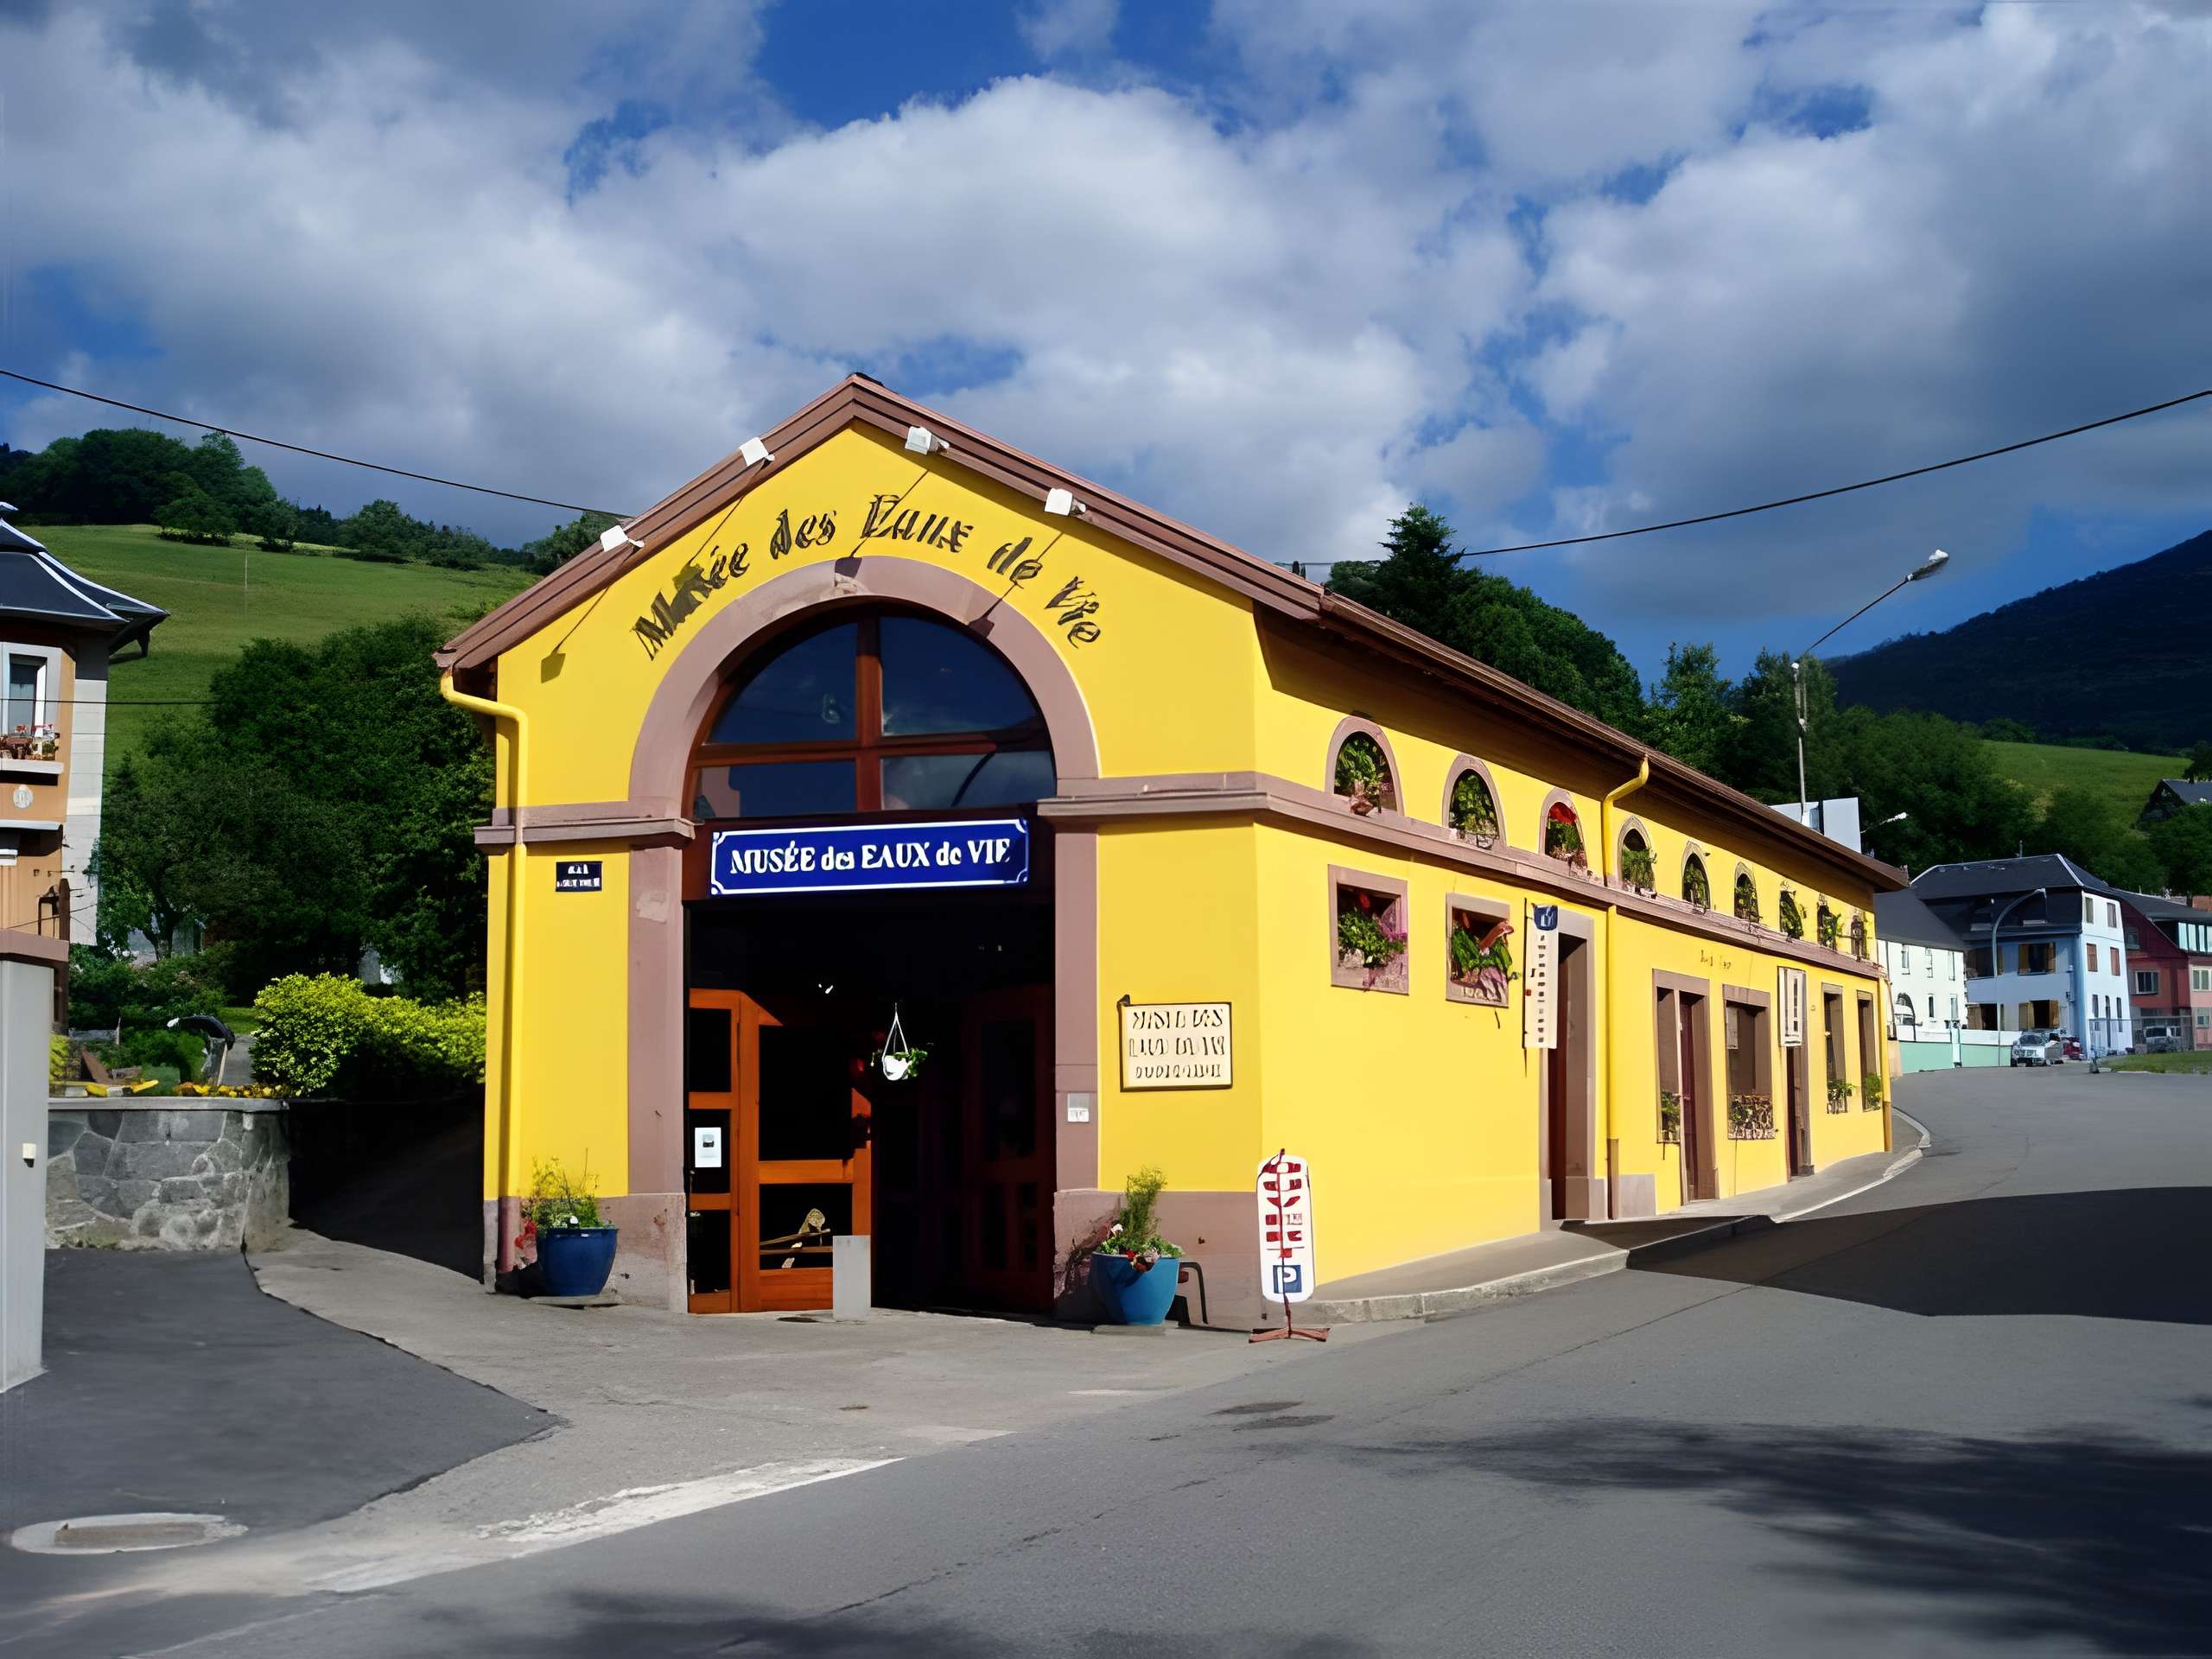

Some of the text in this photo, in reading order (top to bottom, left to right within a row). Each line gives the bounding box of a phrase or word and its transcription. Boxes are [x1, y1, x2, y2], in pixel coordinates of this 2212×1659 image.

[770, 508, 836, 560] des
[987, 537, 1043, 589] de
[730, 840, 816, 874] MUSÉE
[861, 842, 931, 869] EAUX
[936, 841, 962, 867] de
[967, 838, 1010, 864] VIE
